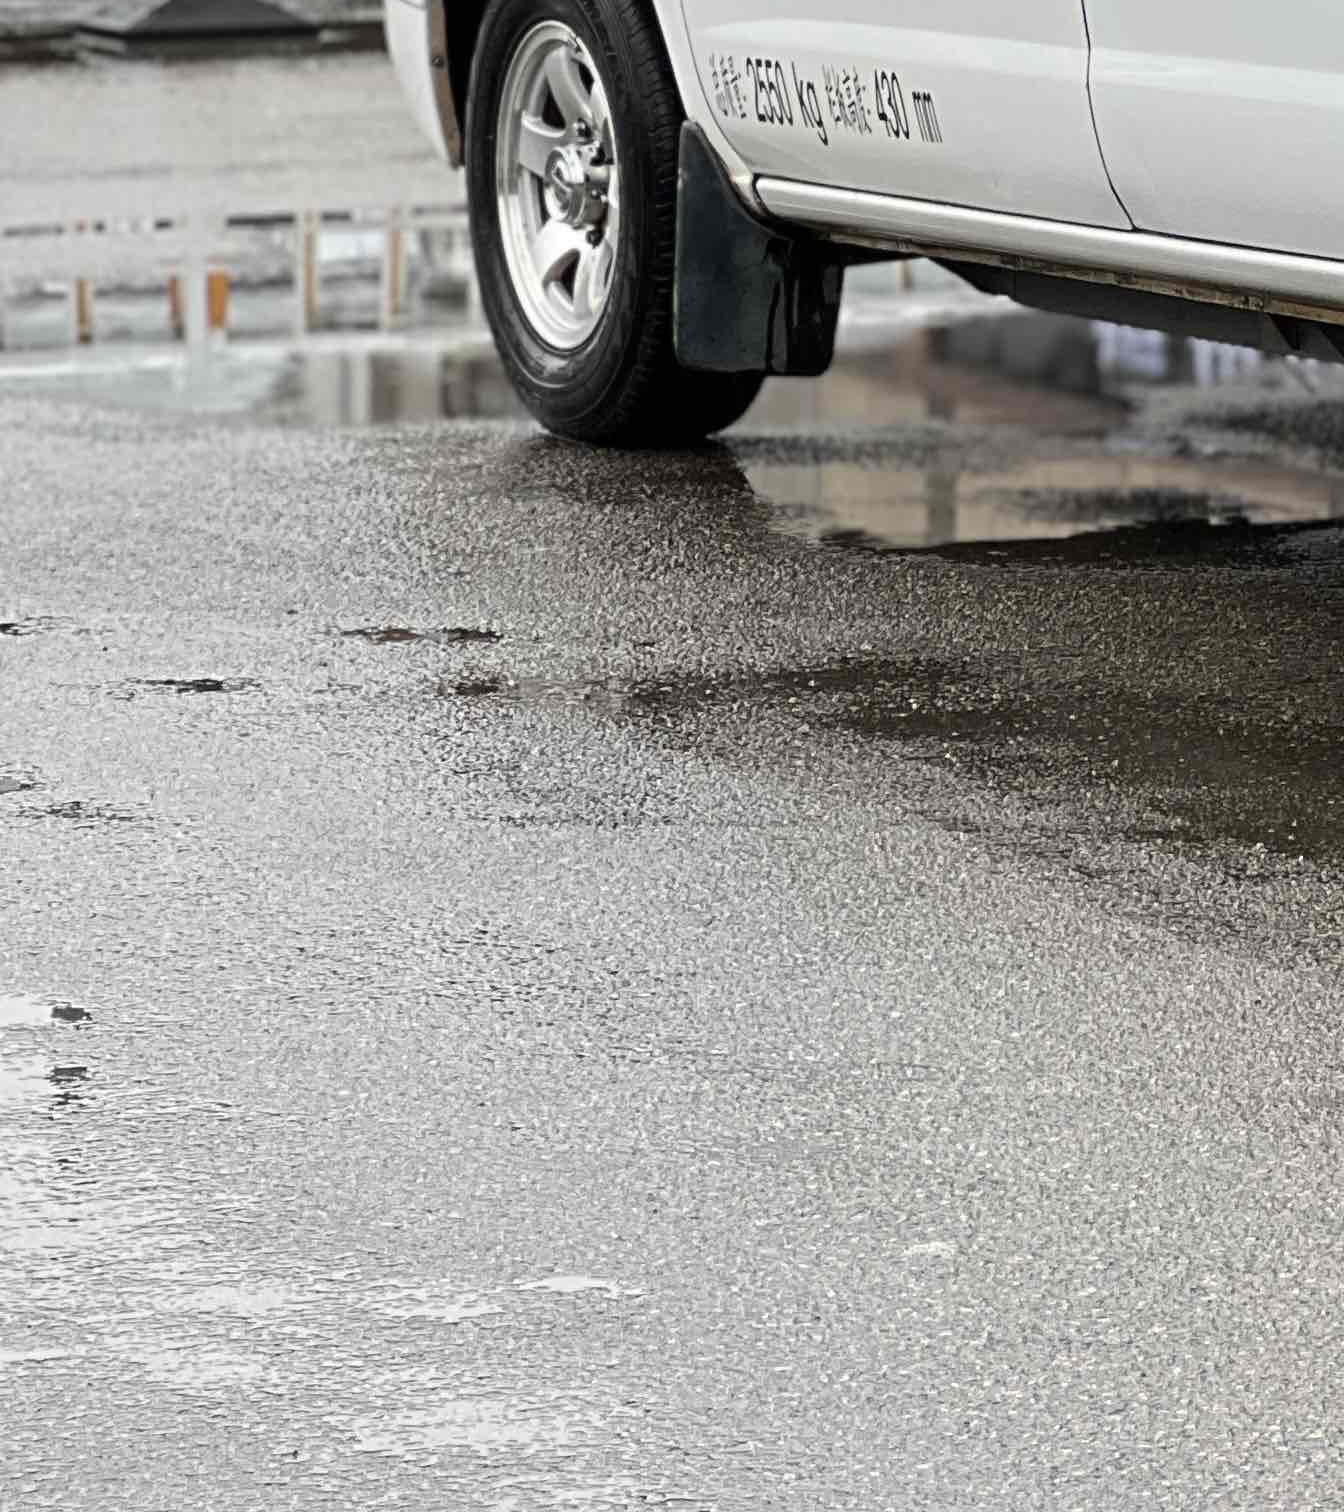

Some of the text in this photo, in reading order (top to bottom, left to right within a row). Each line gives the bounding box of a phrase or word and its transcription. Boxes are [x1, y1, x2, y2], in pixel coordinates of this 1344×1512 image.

[745, 57, 794, 126] 2550
[791, 61, 829, 146] kg
[874, 67, 910, 140] 430
[912, 90, 943, 143] mm
